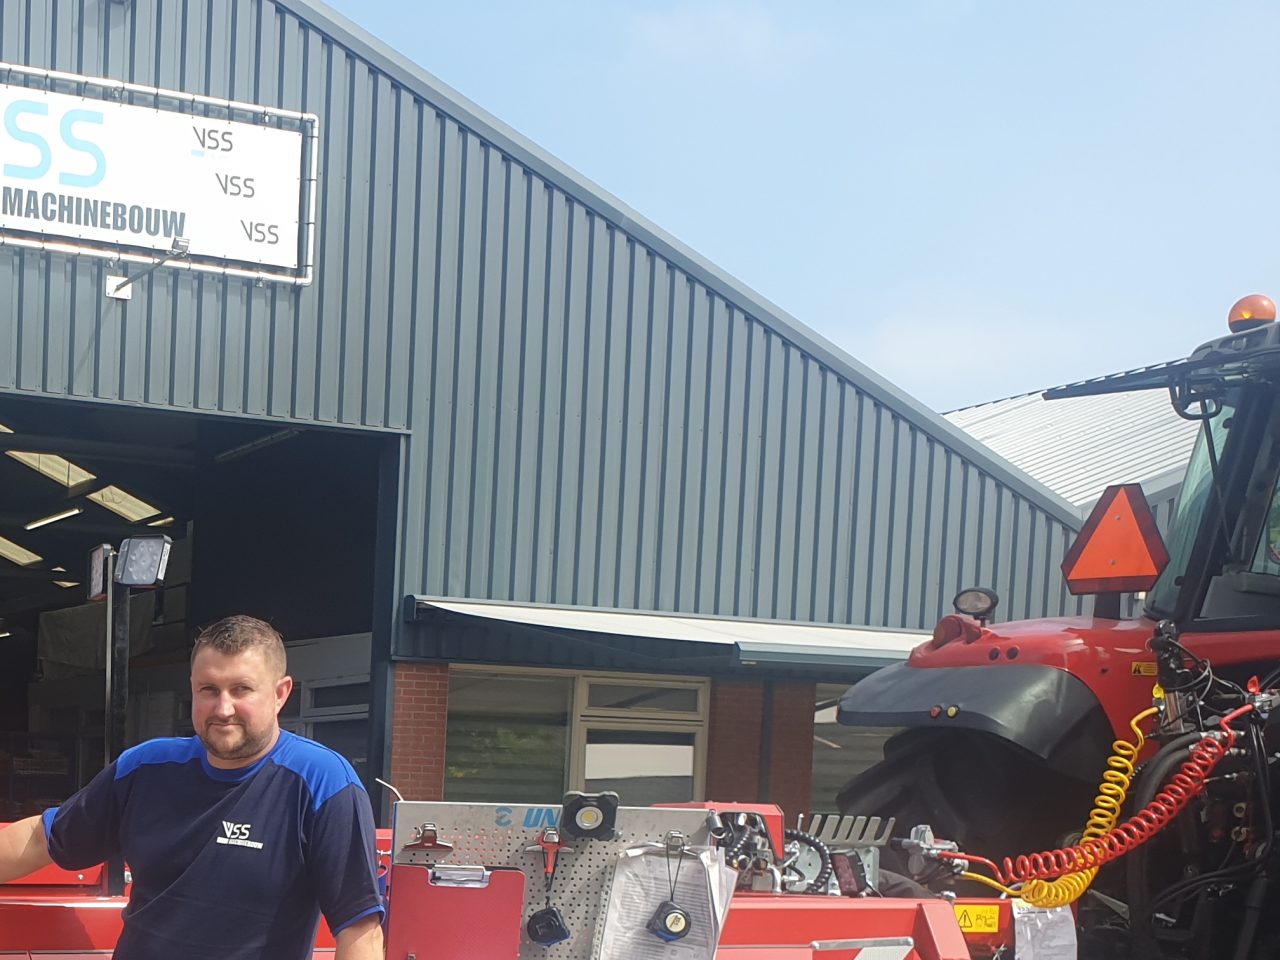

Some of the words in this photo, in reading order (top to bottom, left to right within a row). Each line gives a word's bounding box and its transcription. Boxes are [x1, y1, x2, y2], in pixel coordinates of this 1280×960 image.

[192, 126, 233, 152] VSS
[215, 173, 256, 199] VSS
[2, 186, 187, 239] MACHINEBOUW
[240, 219, 280, 245] VSS
[222, 820, 251, 839] VSS
